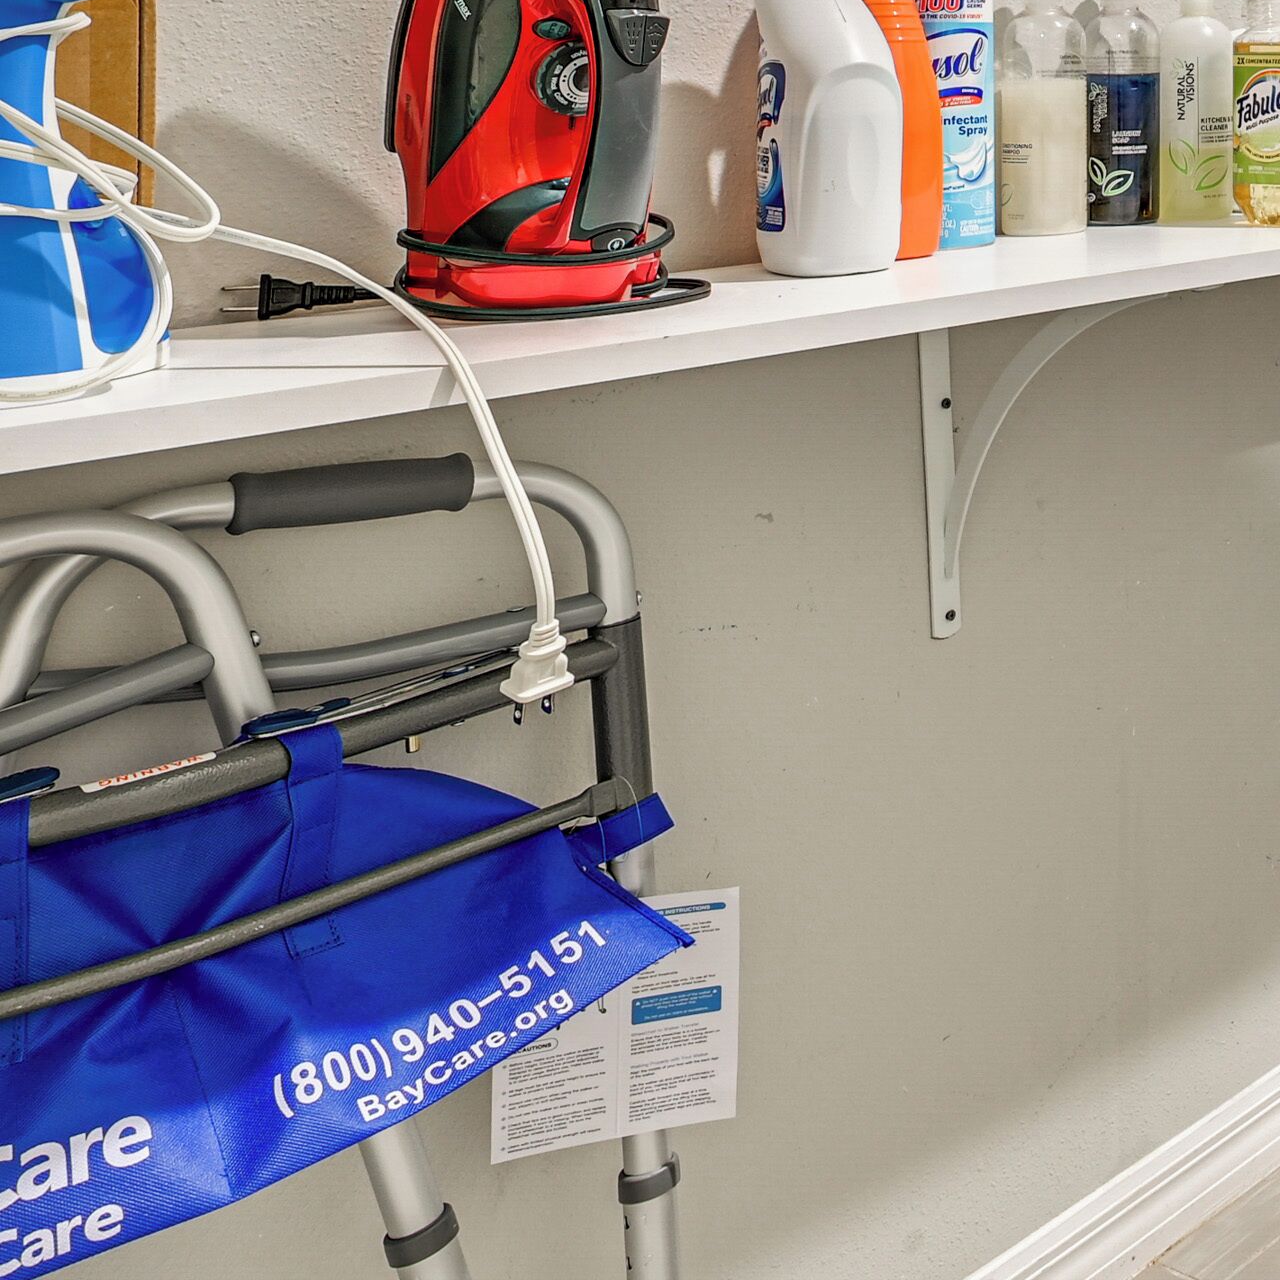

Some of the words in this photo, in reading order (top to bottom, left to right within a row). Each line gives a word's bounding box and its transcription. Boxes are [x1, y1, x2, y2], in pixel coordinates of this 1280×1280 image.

[1237, 57, 1245, 65] 2X
[1177, 76, 1185, 120] NATURAL
[1185, 62, 1194, 103] VISIONS
[958, 126, 988, 137] Spray
[99, 756, 203, 787] WARNING
[665, 905, 711, 915] INSTRUCTIONS
[357, 988, 574, 1121] BayCare.org
